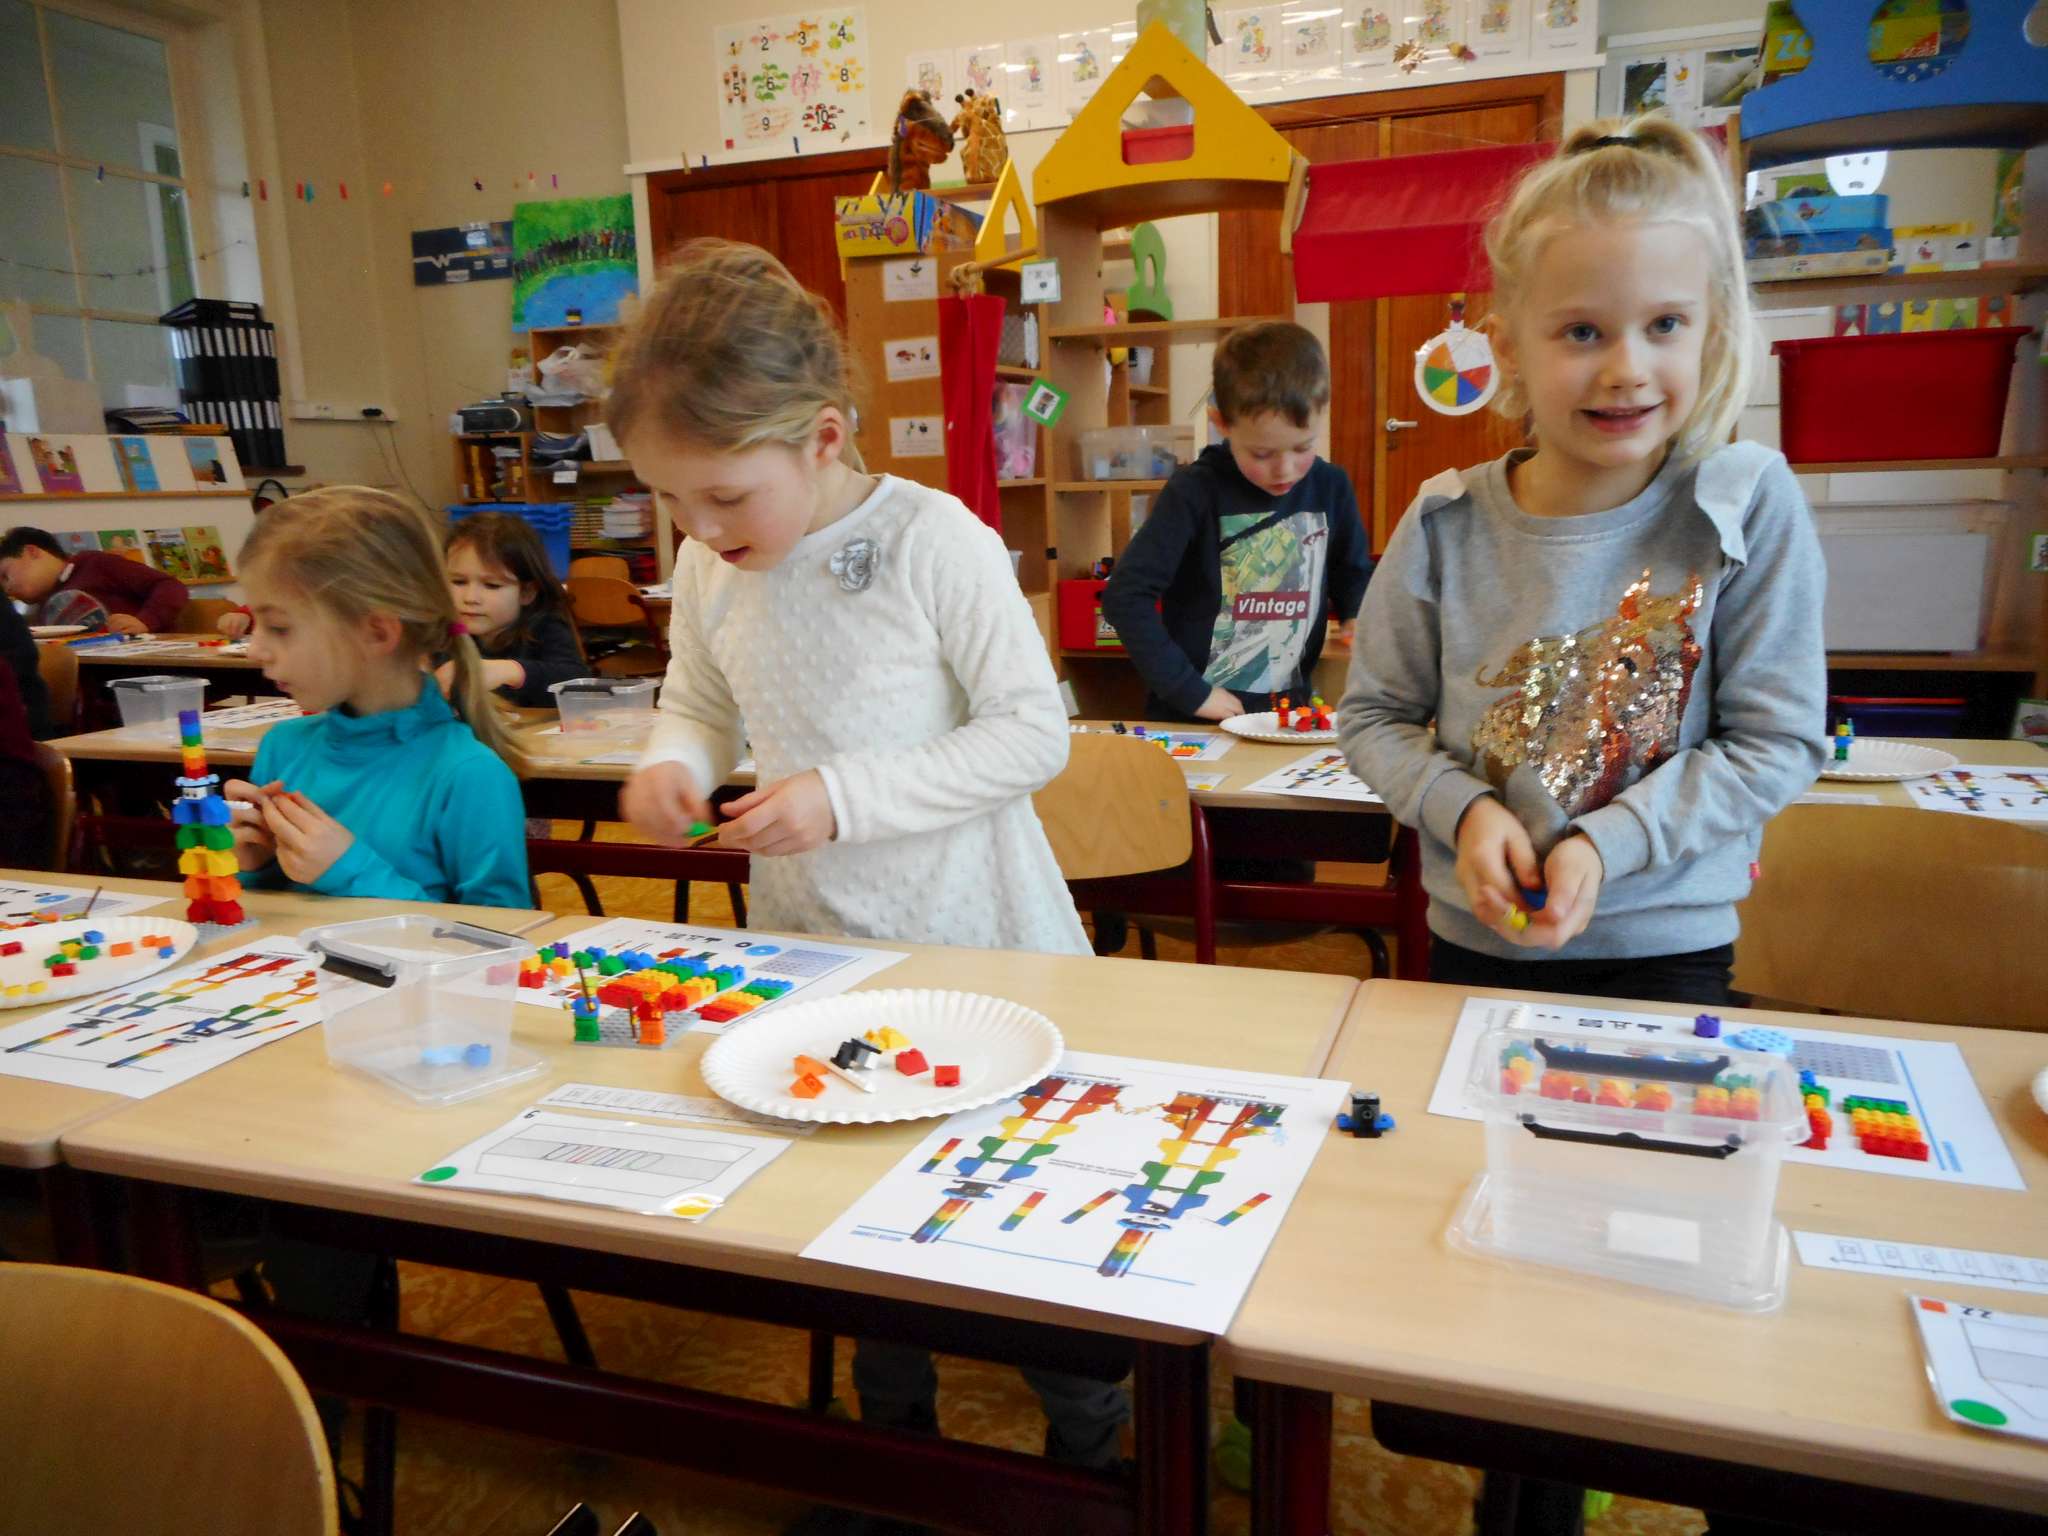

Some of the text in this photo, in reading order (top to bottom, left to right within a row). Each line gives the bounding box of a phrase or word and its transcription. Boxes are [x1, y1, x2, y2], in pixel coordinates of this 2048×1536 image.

[761, 25, 847, 51] 2 3 4
[732, 68, 849, 96] 5 6 7 8
[762, 110, 829, 131] 9 10
[1239, 598, 1306, 616] Vintage
